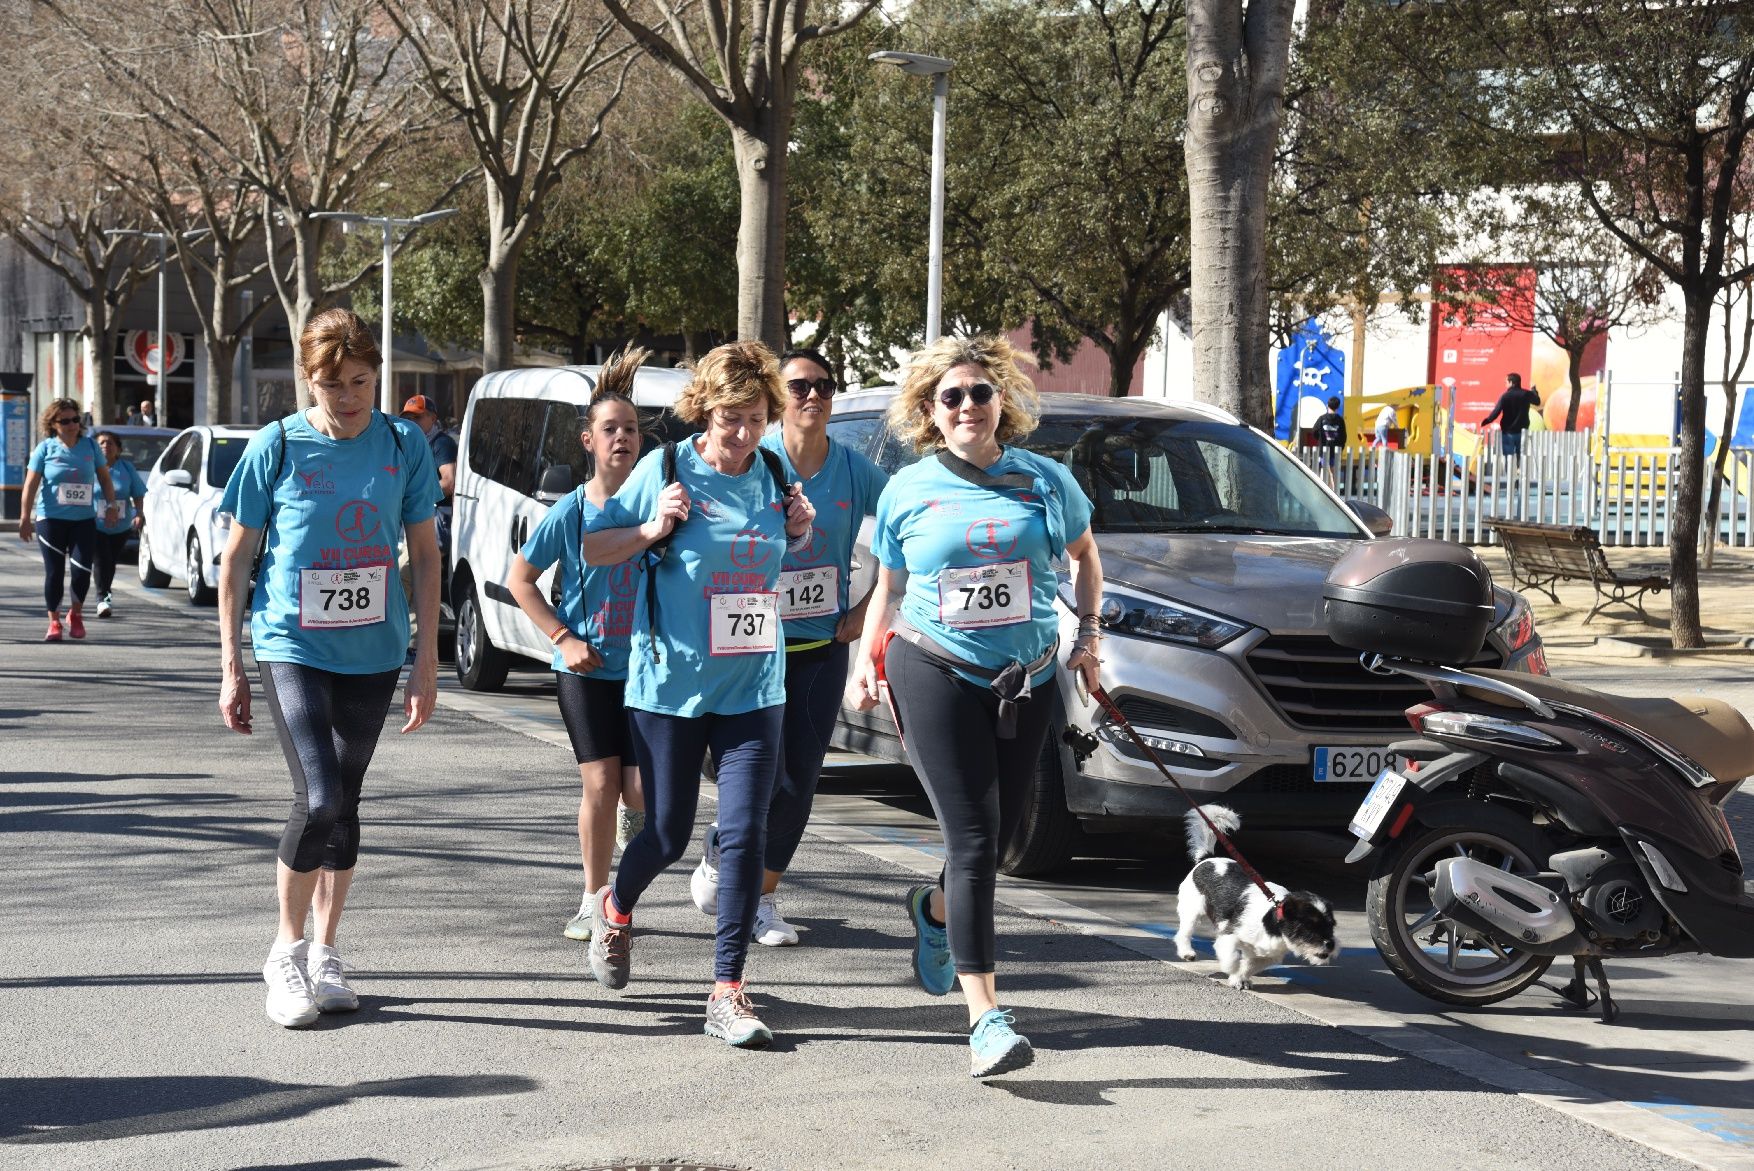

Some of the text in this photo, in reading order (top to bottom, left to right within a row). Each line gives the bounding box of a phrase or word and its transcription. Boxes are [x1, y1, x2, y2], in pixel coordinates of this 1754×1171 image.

[66, 489, 86, 499] 592
[342, 544, 391, 561] CURSA
[319, 586, 371, 611] 738
[785, 583, 825, 606] 142
[960, 583, 1011, 610] 736
[727, 613, 766, 637] 737
[1332, 751, 1397, 778] 6208
